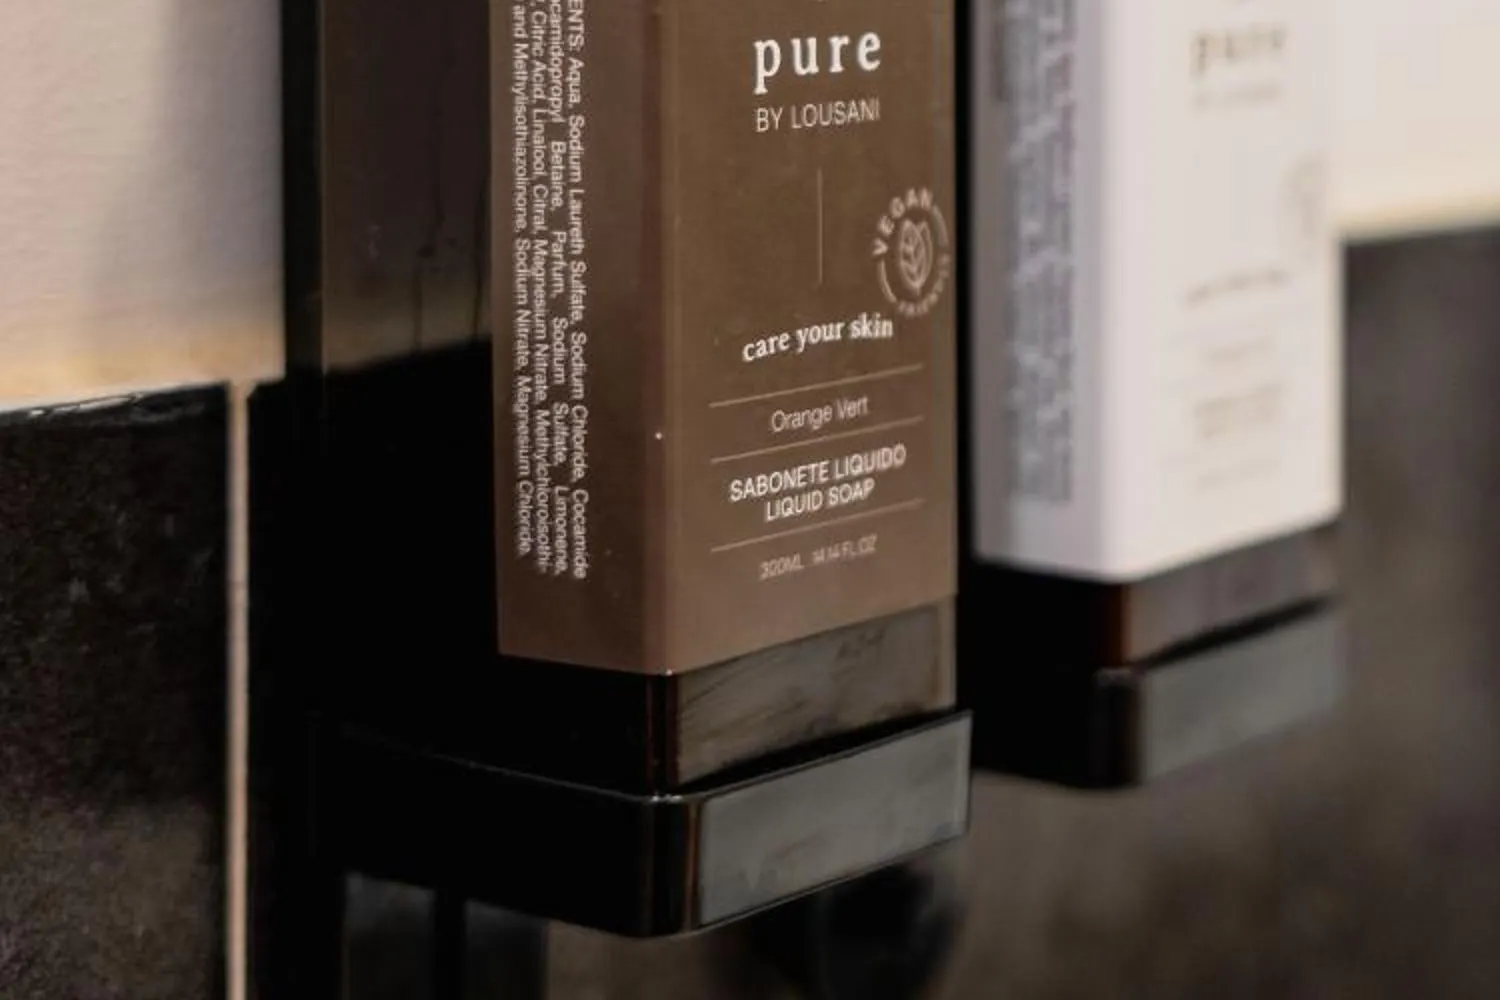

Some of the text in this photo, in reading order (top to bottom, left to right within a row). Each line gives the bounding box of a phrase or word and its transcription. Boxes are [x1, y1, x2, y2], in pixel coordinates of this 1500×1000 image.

[512, 4, 528, 39] and
[530, 10, 546, 57] Citric
[754, 32, 882, 94] pure
[756, 97, 881, 132] BY LOUSANI
[568, 114, 584, 183] Sodium
[568, 188, 584, 255] Laureth
[872, 186, 933, 257] VEGAN
[514, 238, 530, 305] Sodium
[531, 238, 548, 340] Magnesium
[568, 260, 586, 324] Sulfate,
[551, 317, 568, 385] Sodium
[569, 331, 586, 400] Sodium
[742, 312, 894, 362] care your skin
[511, 375, 532, 476] Magnesium
[569, 404, 588, 482] Chloride,
[771, 397, 869, 432] Orange Vert
[730, 443, 907, 502] SABONETE LIQUIDO
[766, 478, 876, 523] LIQUID SOAP
[571, 488, 589, 579] Cocamide
